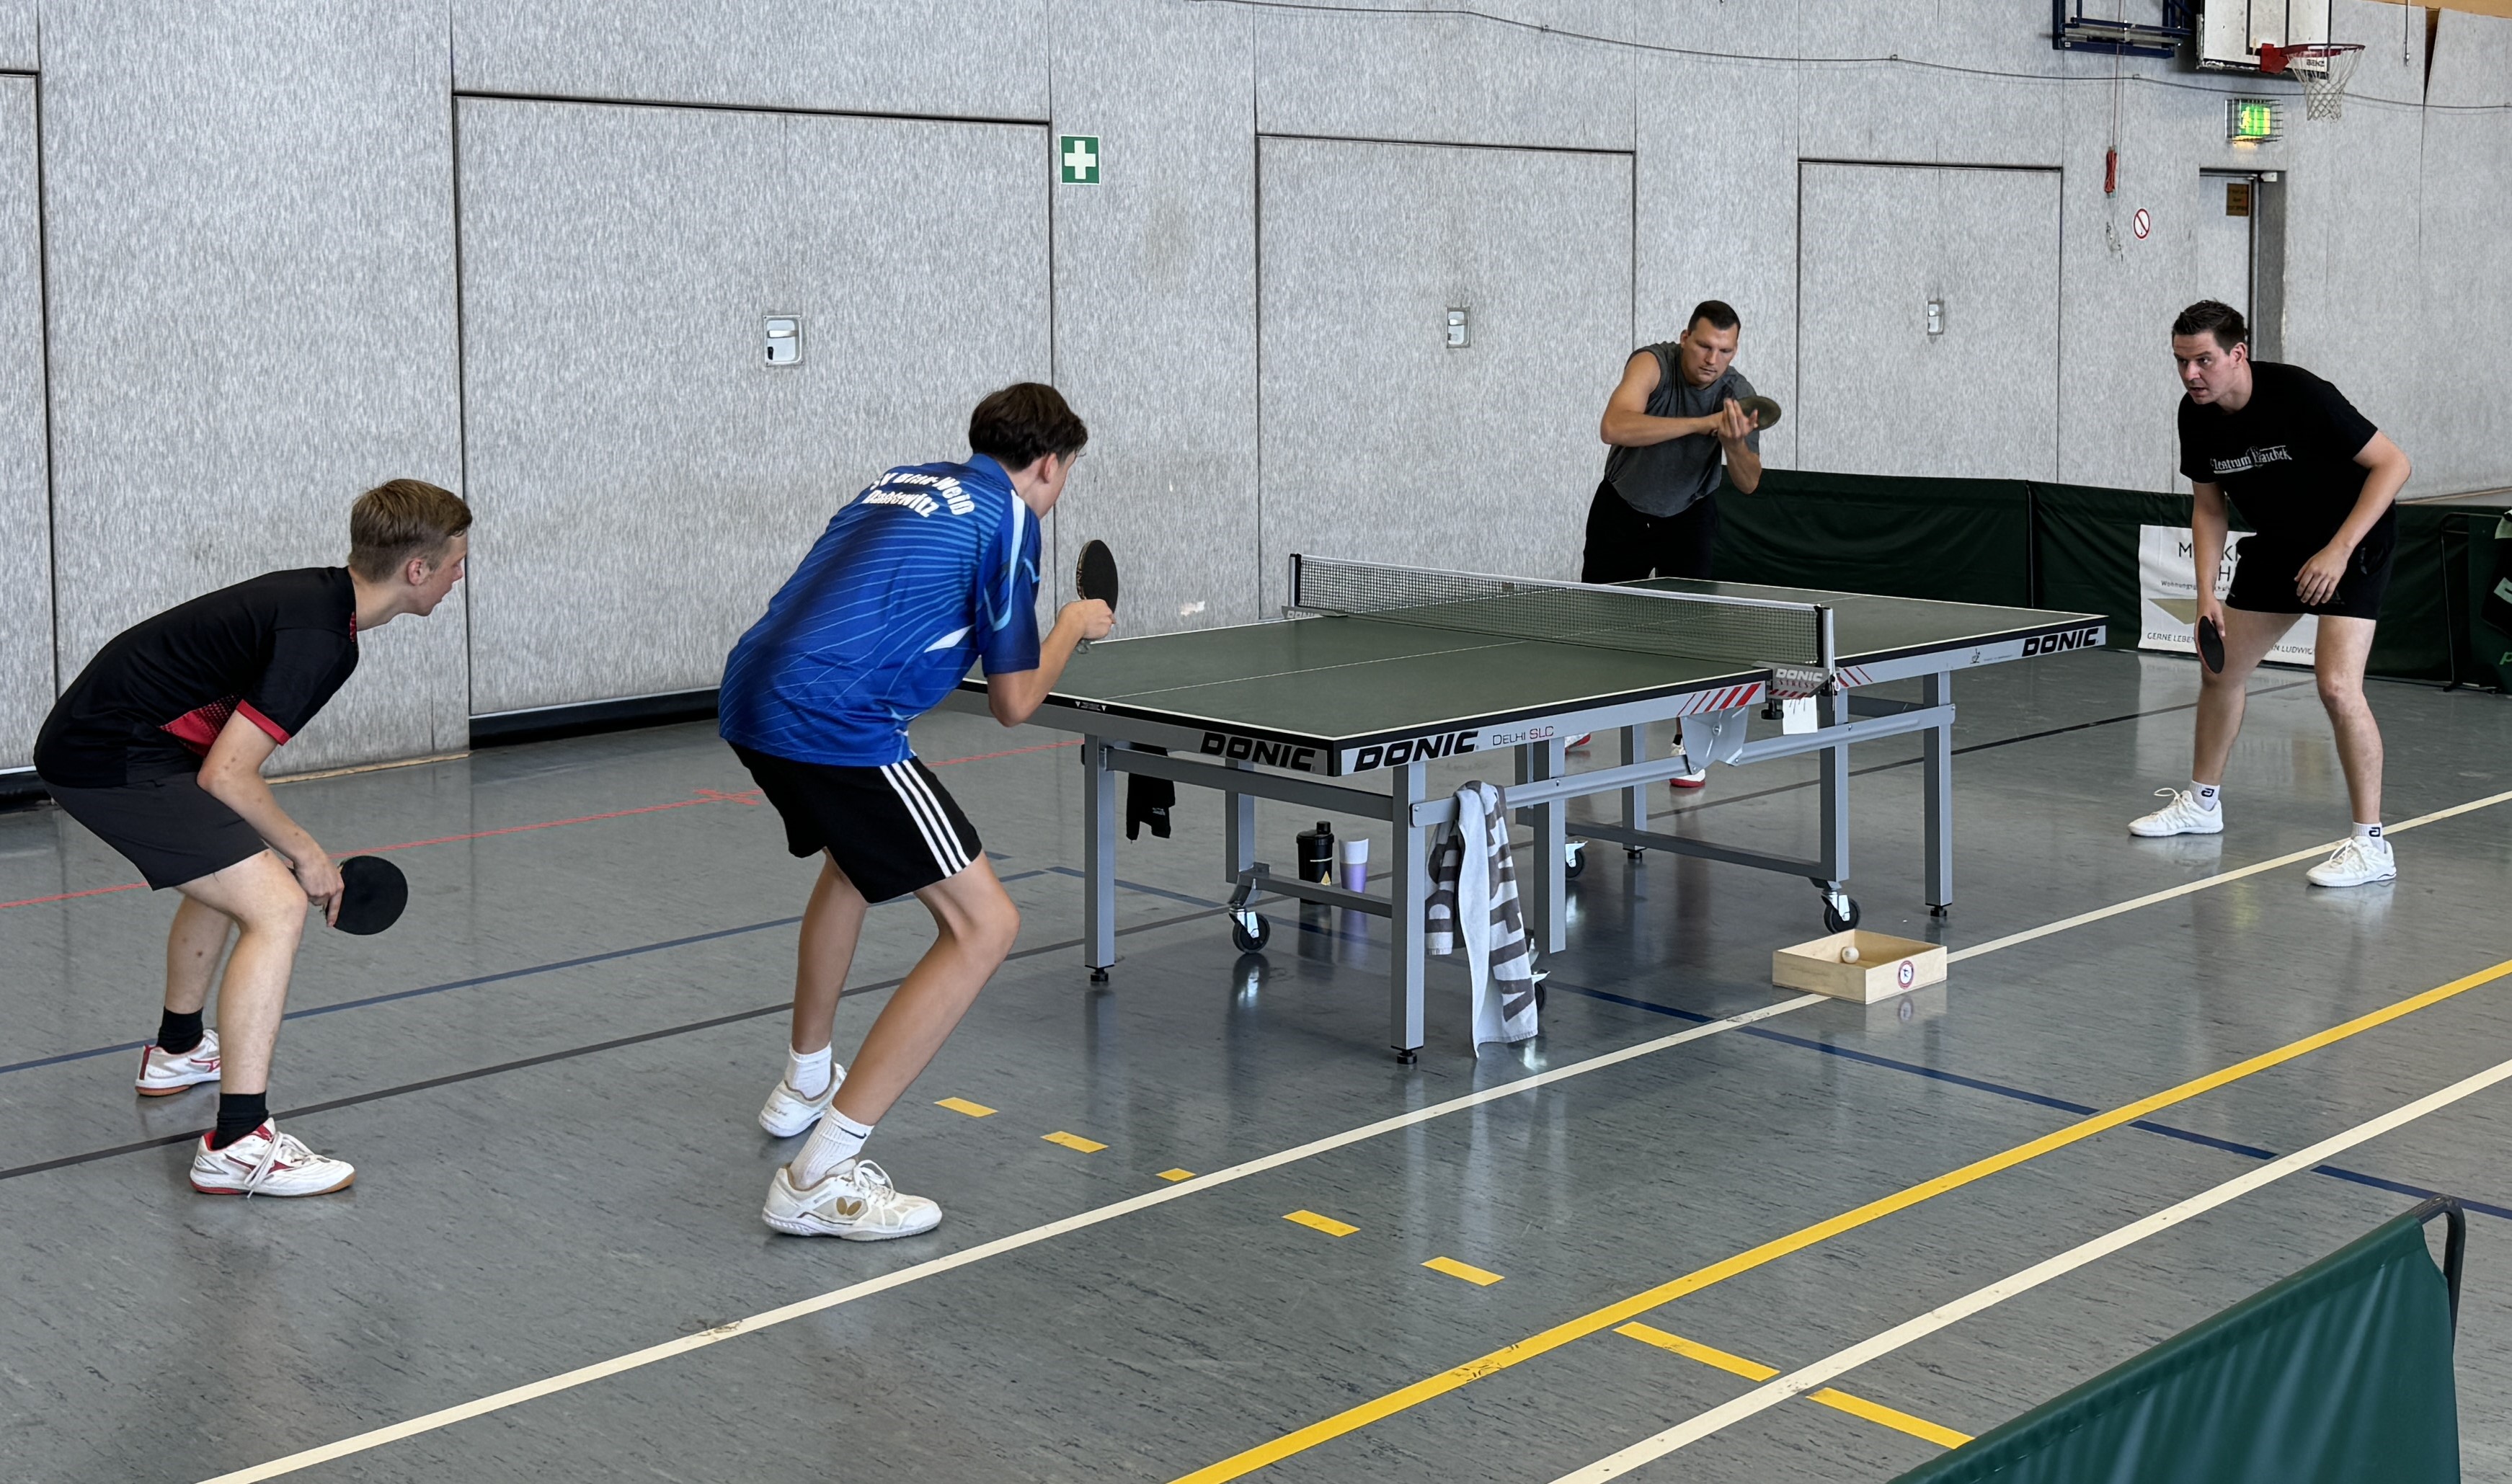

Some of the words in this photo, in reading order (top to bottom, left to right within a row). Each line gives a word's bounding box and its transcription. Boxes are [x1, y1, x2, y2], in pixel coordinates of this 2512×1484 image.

[2022, 628, 2099, 657] DONIC
[2147, 632, 2172, 641] GERNE
[1776, 668, 1823, 683] DONIC
[1200, 732, 1316, 772] DONIC
[1354, 731, 1479, 772] DONIC
[1530, 726, 1554, 739] SLC
